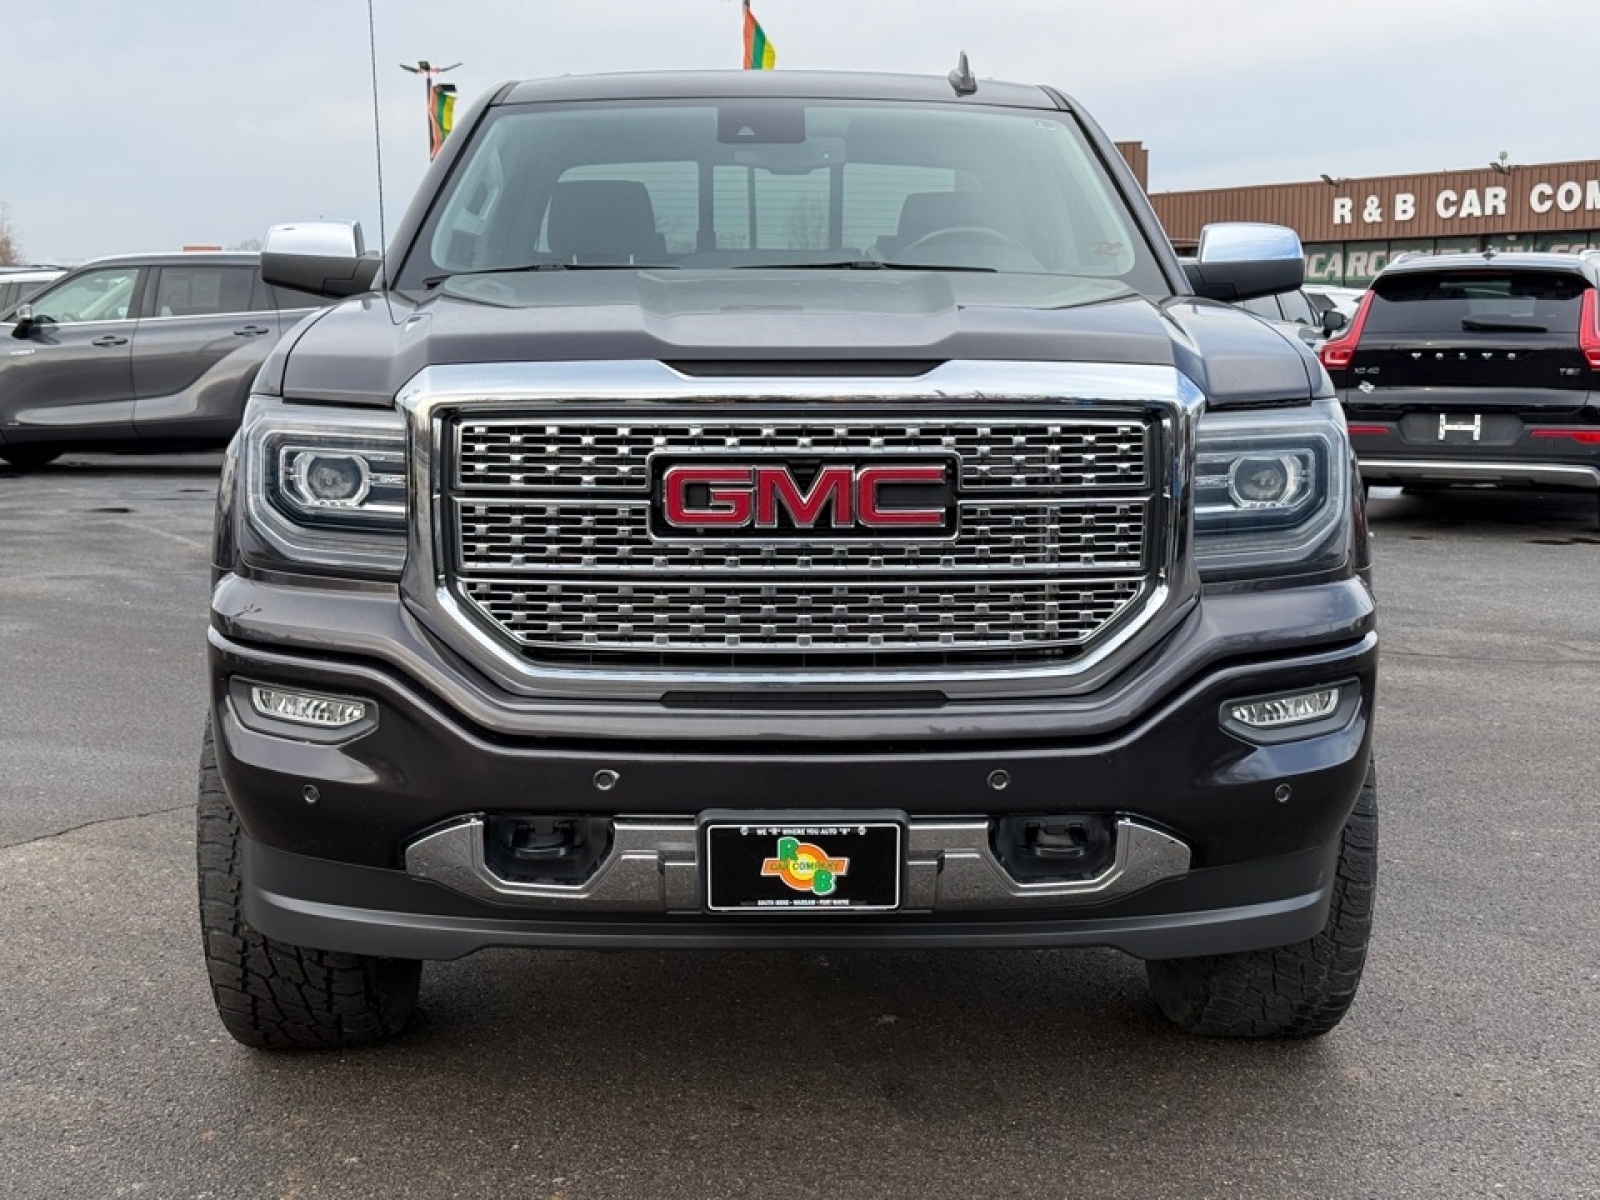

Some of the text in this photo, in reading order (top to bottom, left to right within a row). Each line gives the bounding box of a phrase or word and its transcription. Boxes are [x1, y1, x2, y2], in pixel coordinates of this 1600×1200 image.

[1333, 197, 1352, 224] R
[1363, 195, 1382, 223] &
[1395, 193, 1415, 221] B
[1436, 186, 1507, 219] CAR
[1411, 352, 1516, 360] VOLVO
[663, 465, 946, 528] GMC
[778, 837, 799, 861] R
[813, 868, 834, 894] B
